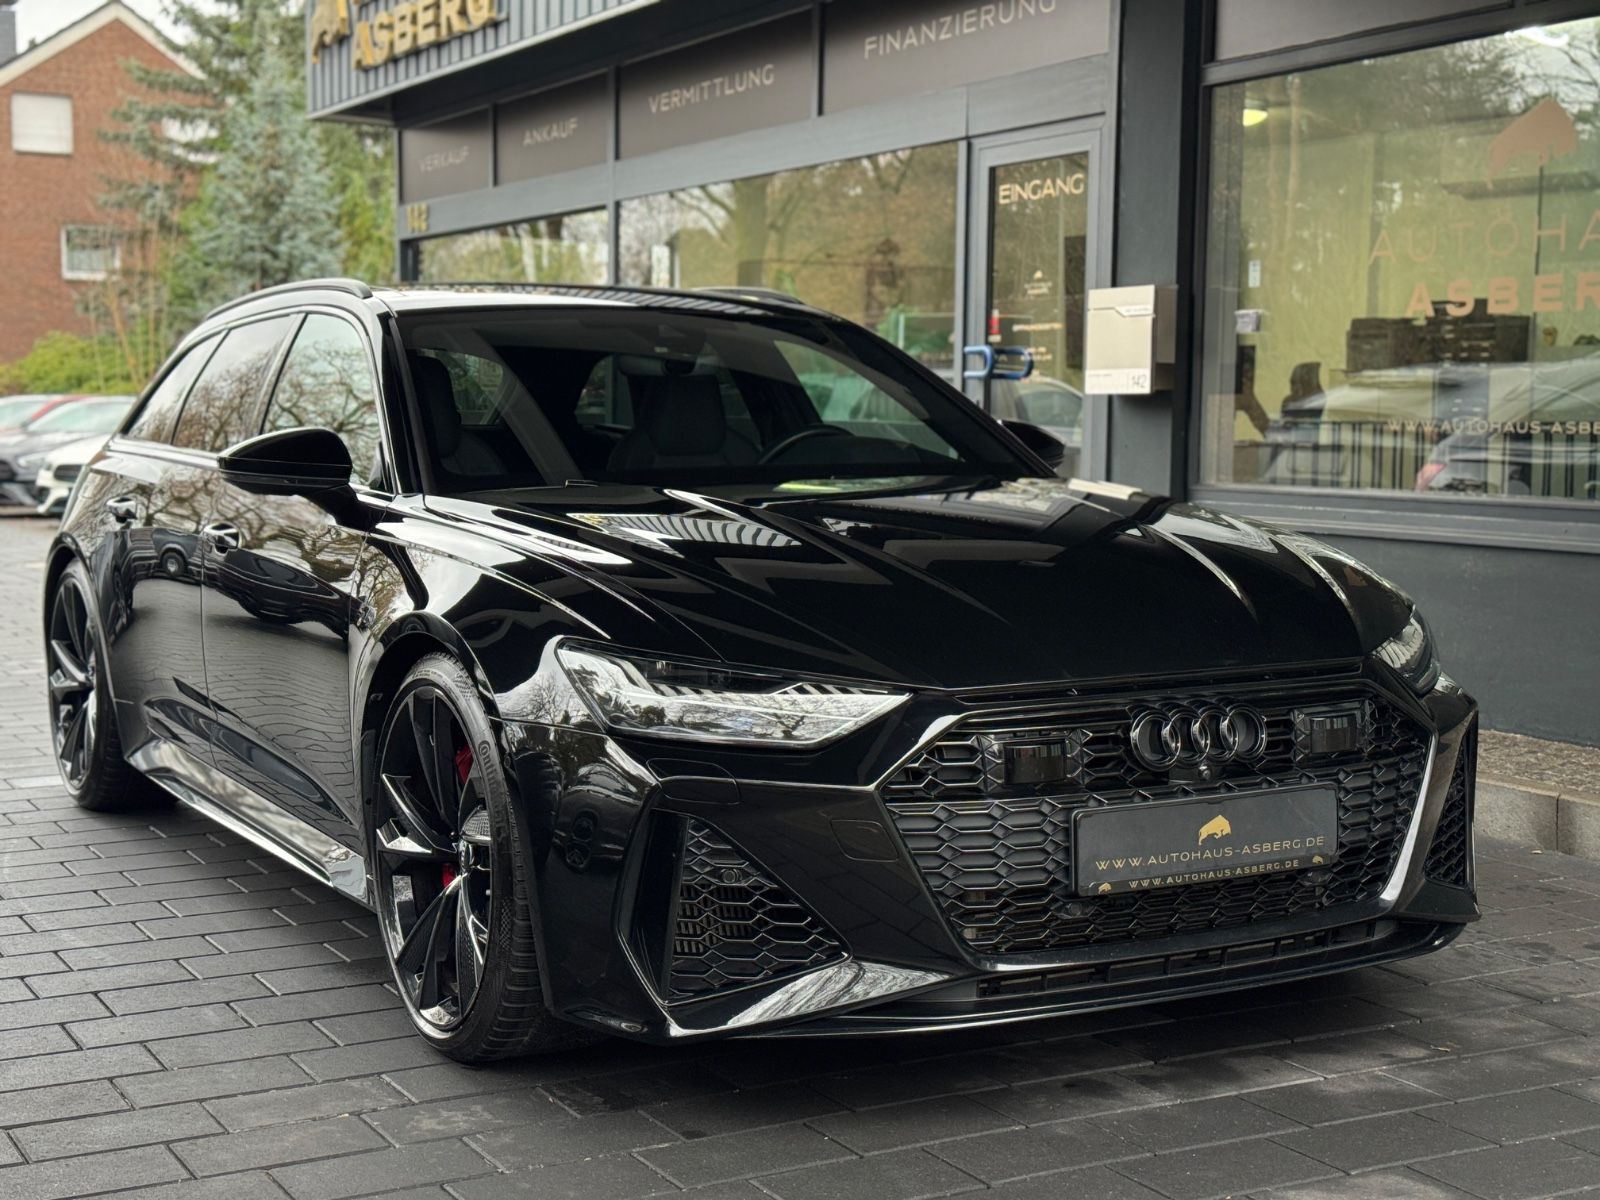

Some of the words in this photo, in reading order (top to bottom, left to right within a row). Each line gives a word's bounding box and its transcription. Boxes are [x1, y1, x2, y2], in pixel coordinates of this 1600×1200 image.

[863, 0, 1057, 60] FINANZIERUNG
[648, 64, 775, 114] VERMITTLUNG
[522, 116, 579, 147] ANKAUF
[418, 145, 470, 172] VERKAUF
[998, 173, 1085, 206] EINGANG
[1095, 836, 1325, 871] WWW.AUTOHAUS-ASBERG.DE
[1128, 858, 1300, 888] WWW.AUTOHAUS-ASBERG.DE
